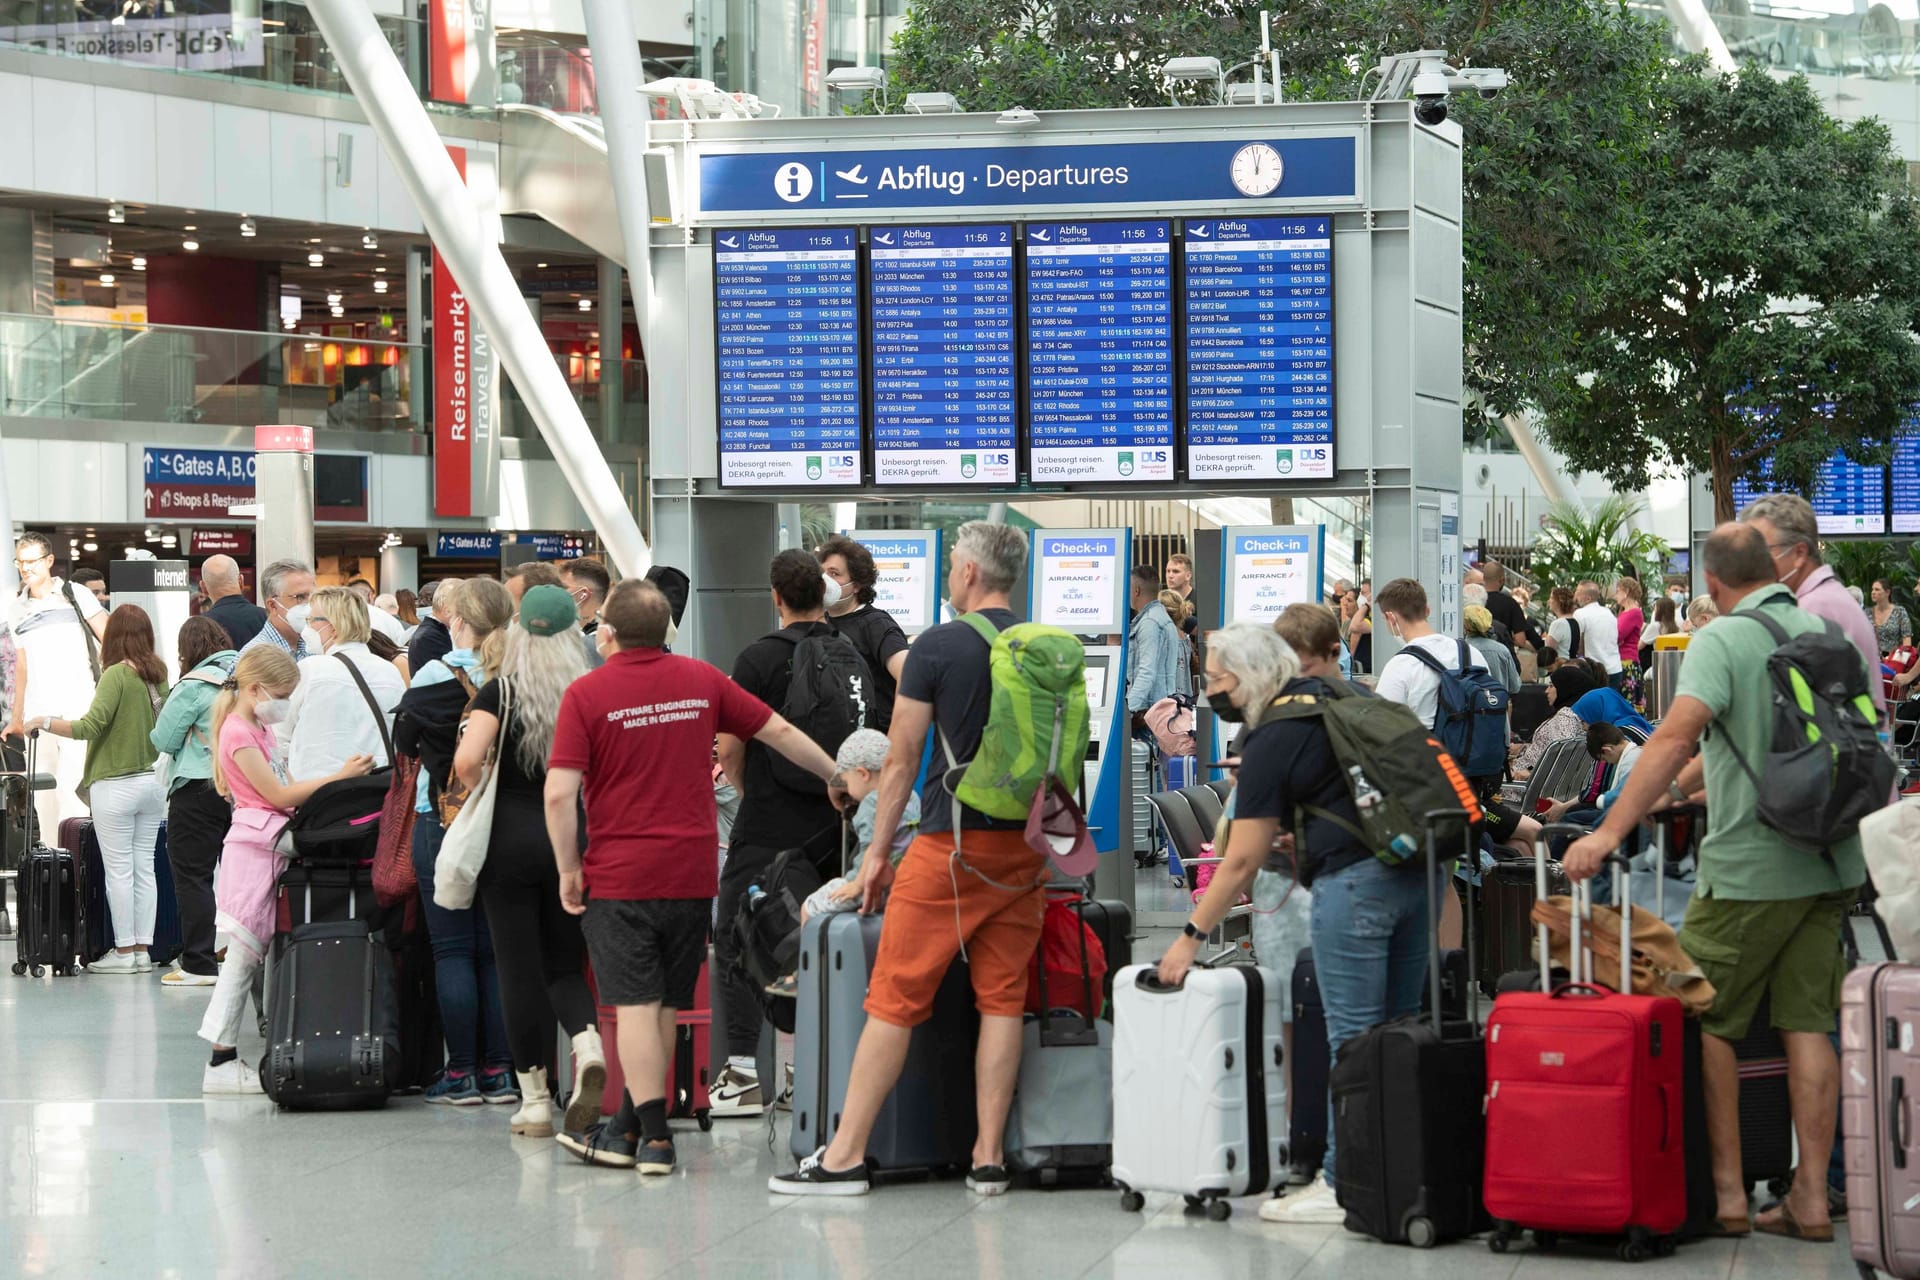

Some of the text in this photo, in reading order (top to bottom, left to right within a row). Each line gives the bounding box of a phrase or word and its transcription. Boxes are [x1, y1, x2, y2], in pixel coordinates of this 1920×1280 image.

[877, 164, 1128, 195] Abflug Departures
[1060, 226, 1164, 238] Abflug 11:56 3
[1218, 223, 1324, 234] Abflug 11:56 4
[748, 234, 849, 245] Abflug 11:56 1
[904, 230, 1006, 242] Abflug 11:56 2
[450, 292, 466, 440] Reisemarkt
[474, 364, 488, 443] Travel
[984, 454, 1008, 464] DUS
[1038, 456, 1077, 464] Unbesorgt
[1141, 451, 1166, 462] DUS
[1195, 454, 1235, 462] Unbesorgt
[1300, 449, 1326, 460] DUS
[173, 454, 256, 480] Gates A,B,C
[728, 460, 767, 469] Unbesorgt
[828, 456, 853, 467] DUS
[882, 458, 921, 466] Unbesorgt
[911, 468, 940, 477] geprüft.
[1067, 466, 1096, 475] geprüft.
[1225, 464, 1255, 472] geprüft.
[757, 470, 786, 479] geprüft.
[173, 489, 202, 510] Shops
[203, 493, 210, 507] &
[456, 538, 492, 550] Gates A,B,C
[1052, 542, 1107, 554] Check-in
[1244, 540, 1300, 551] Check-in
[154, 568, 187, 586] Internet
[607, 699, 710, 722] SOFTWARE ENGINEERING
[623, 711, 700, 730] MADE IN GERMANY
